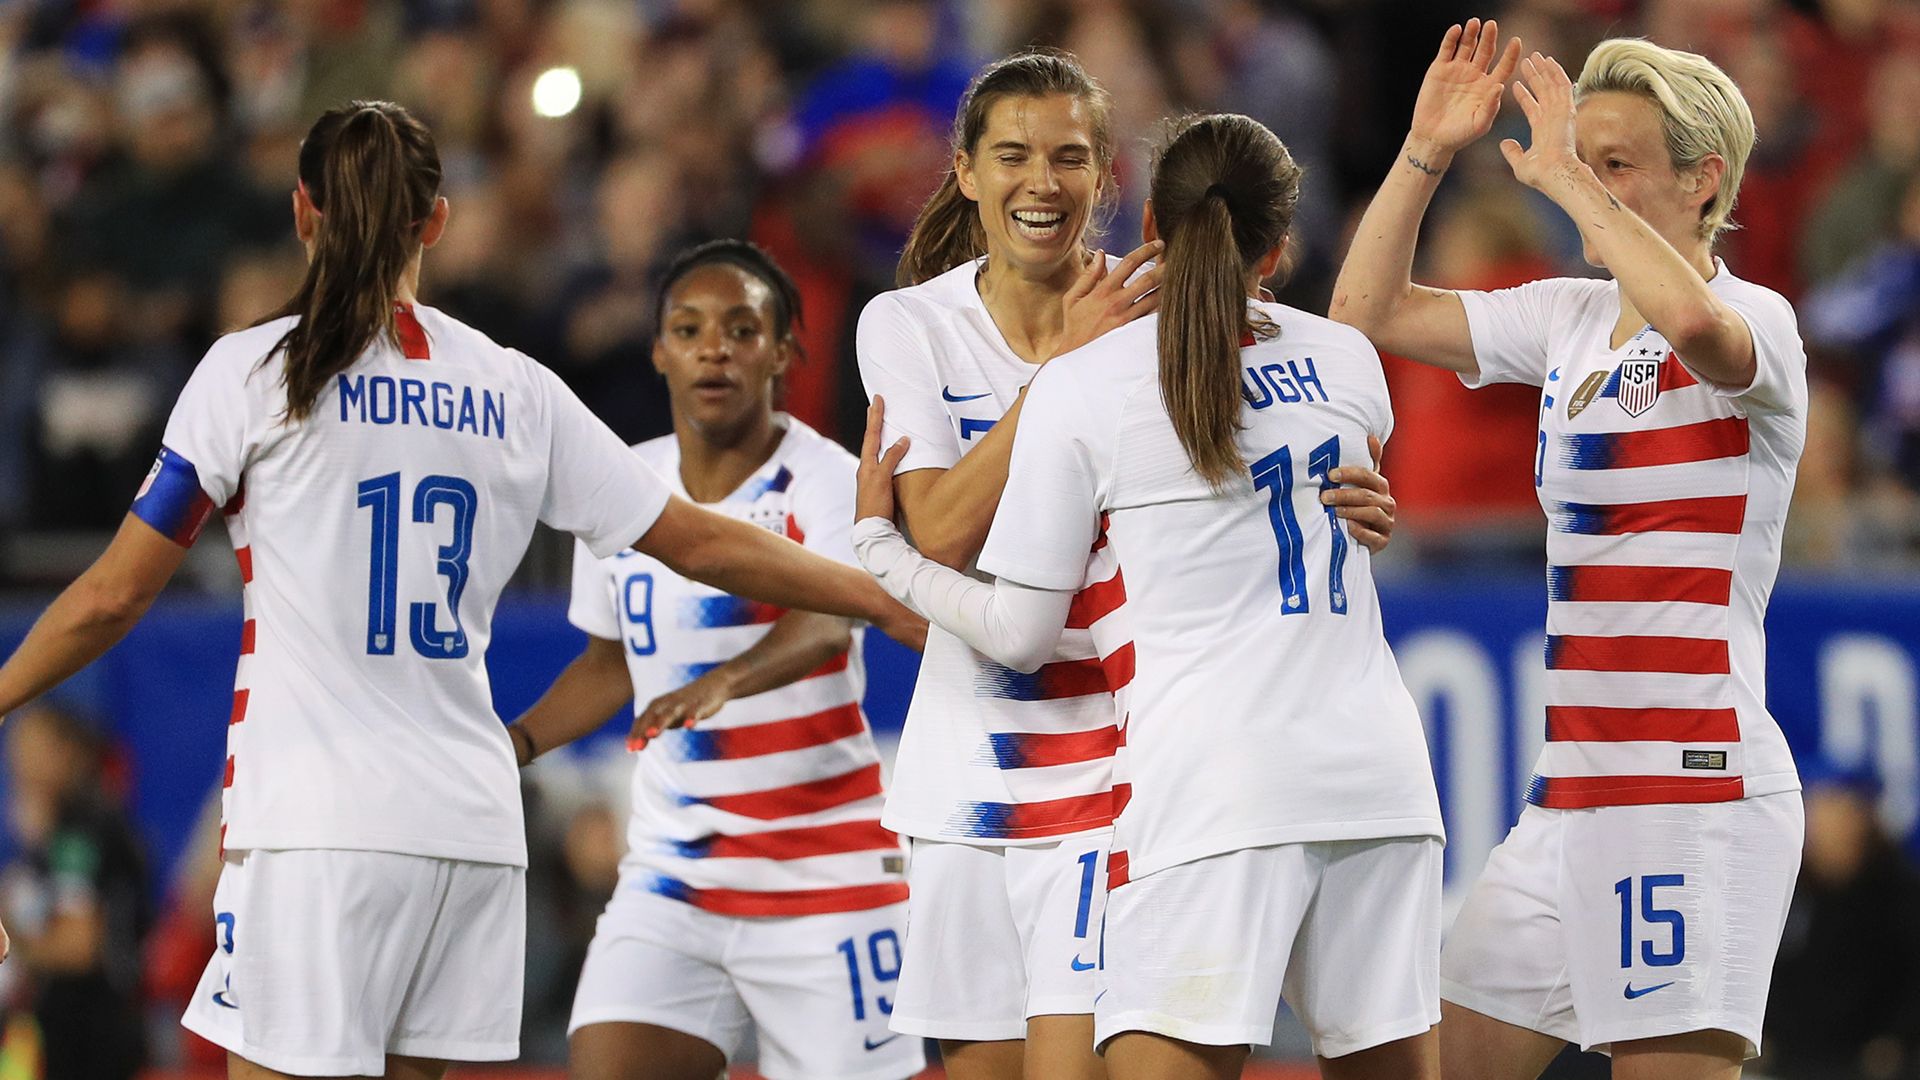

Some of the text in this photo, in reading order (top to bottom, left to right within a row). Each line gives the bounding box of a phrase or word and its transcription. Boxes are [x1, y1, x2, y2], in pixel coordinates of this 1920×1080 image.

[338, 373, 505, 440] MORGAN
[1623, 364, 1656, 385] USA
[357, 471, 478, 660] 13
[1251, 434, 1348, 616] 11
[1614, 874, 1685, 969] 15
[838, 928, 903, 1021] 19
